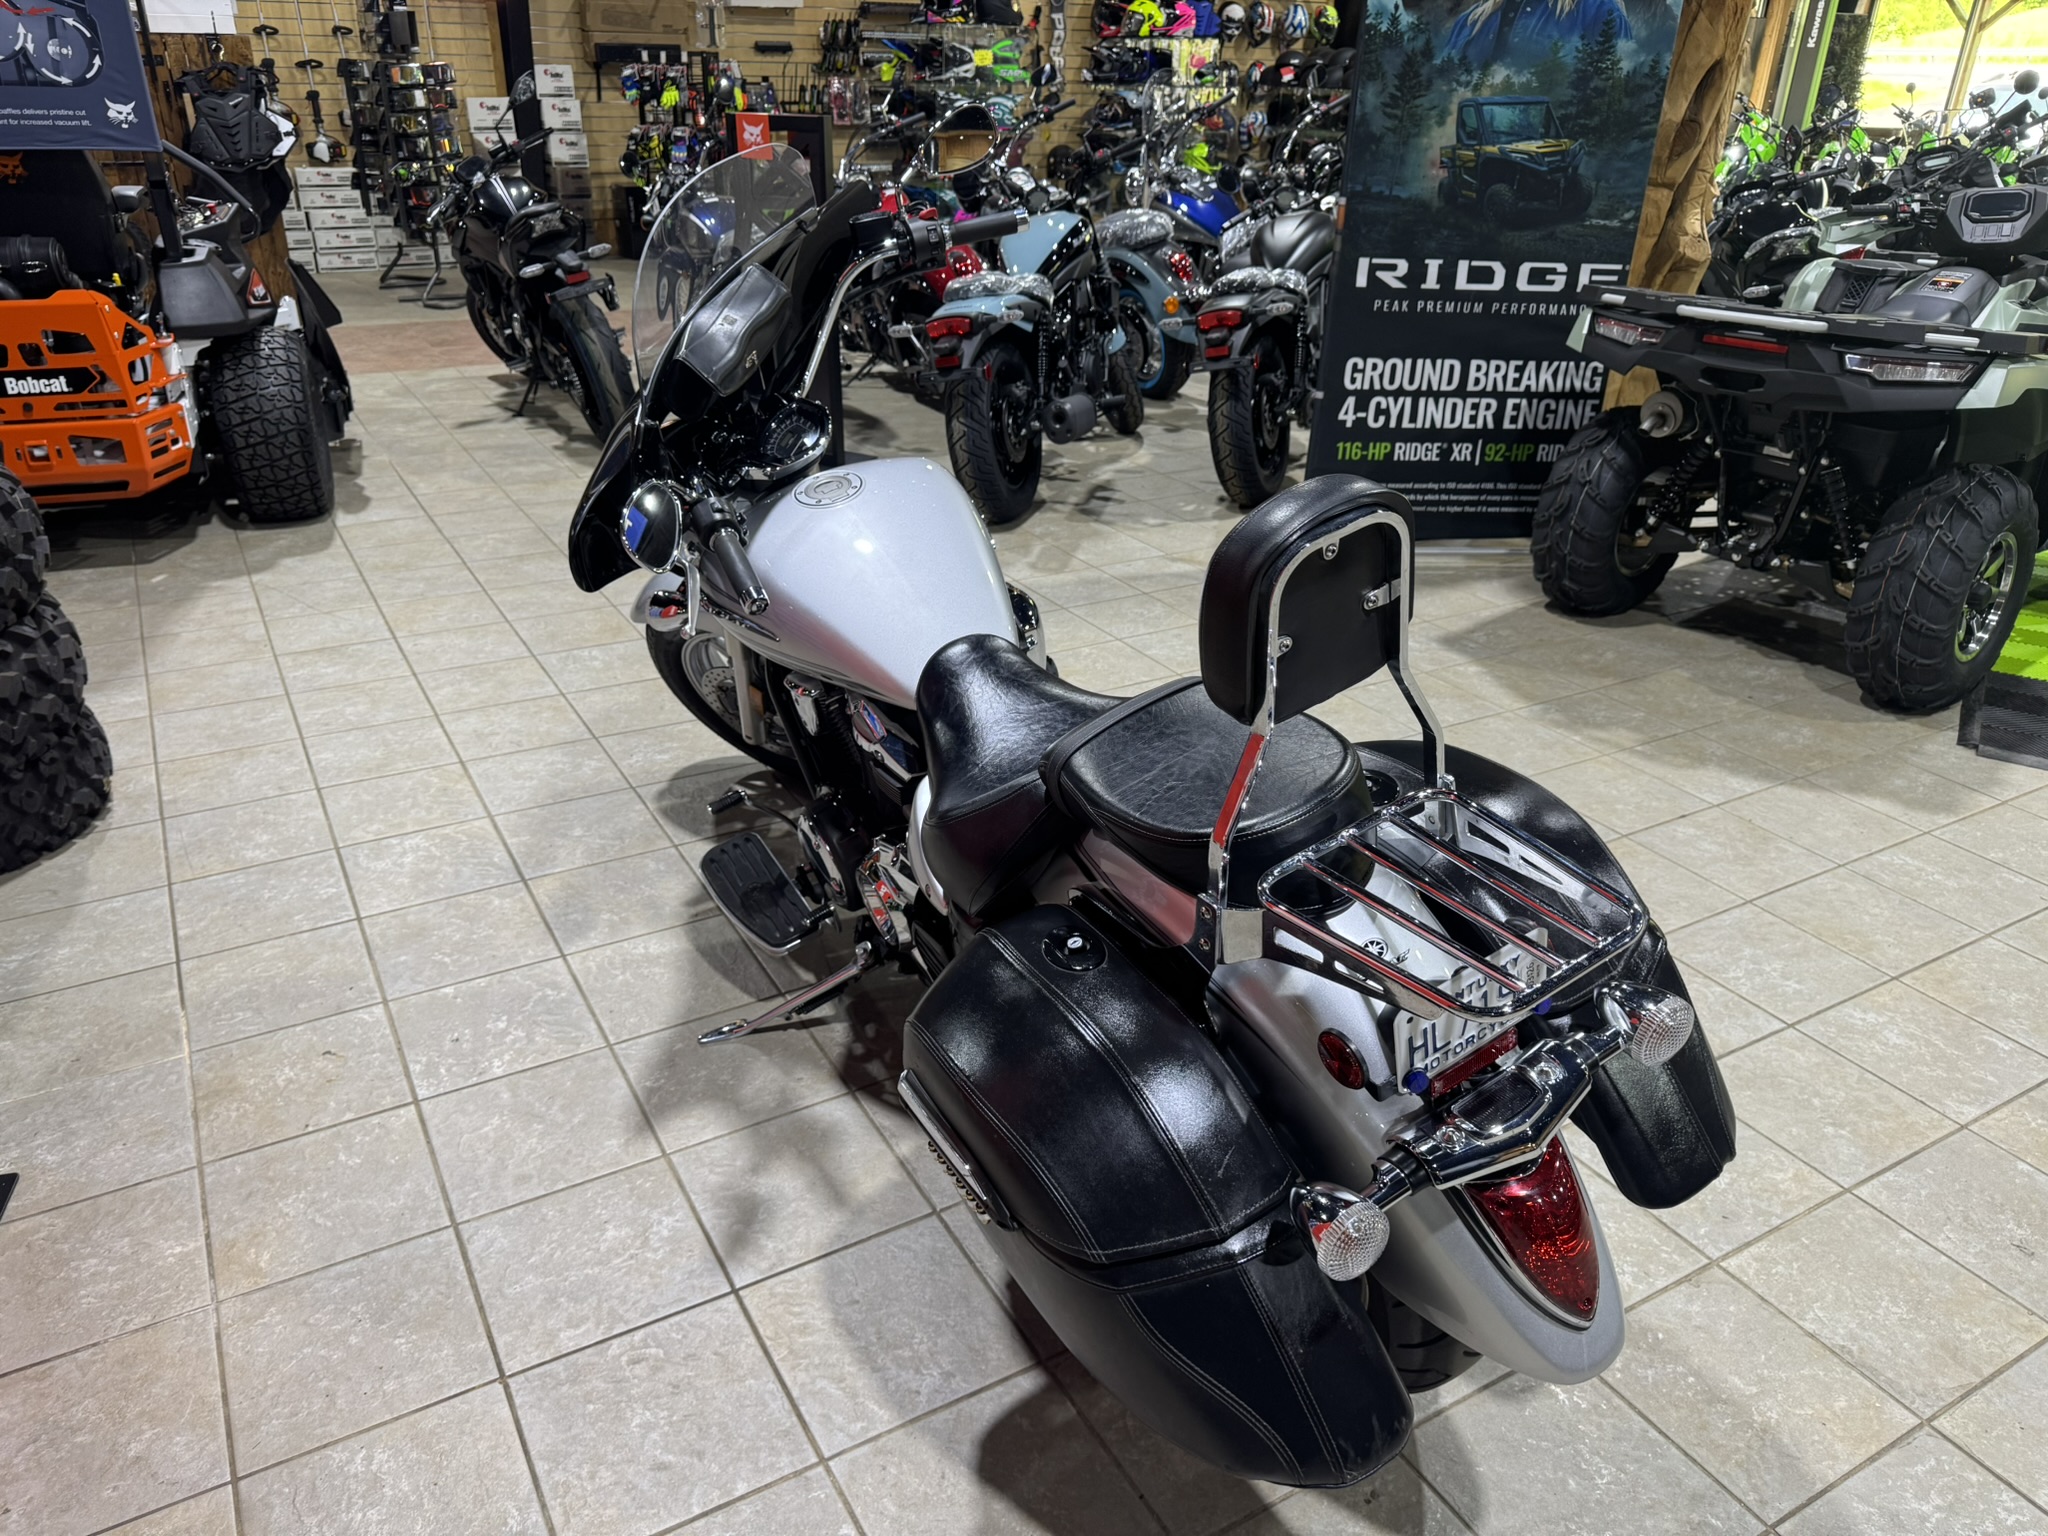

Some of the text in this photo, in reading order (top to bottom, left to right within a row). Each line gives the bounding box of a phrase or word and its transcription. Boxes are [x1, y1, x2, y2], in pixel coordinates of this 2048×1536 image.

[1355, 256, 1624, 292] RIDGE
[1373, 299, 1409, 312] PEAK
[1417, 301, 1483, 314] PREMIUM
[4, 375, 69, 395] Bobcat
[1343, 357, 1604, 393] GROUND BREAKING
[1338, 396, 1600, 430] 4-CYLINDER ENGINE
[1336, 442, 1391, 461] 116-HP
[1450, 443, 1473, 462] XR
[1484, 443, 1535, 462] 92-HP
